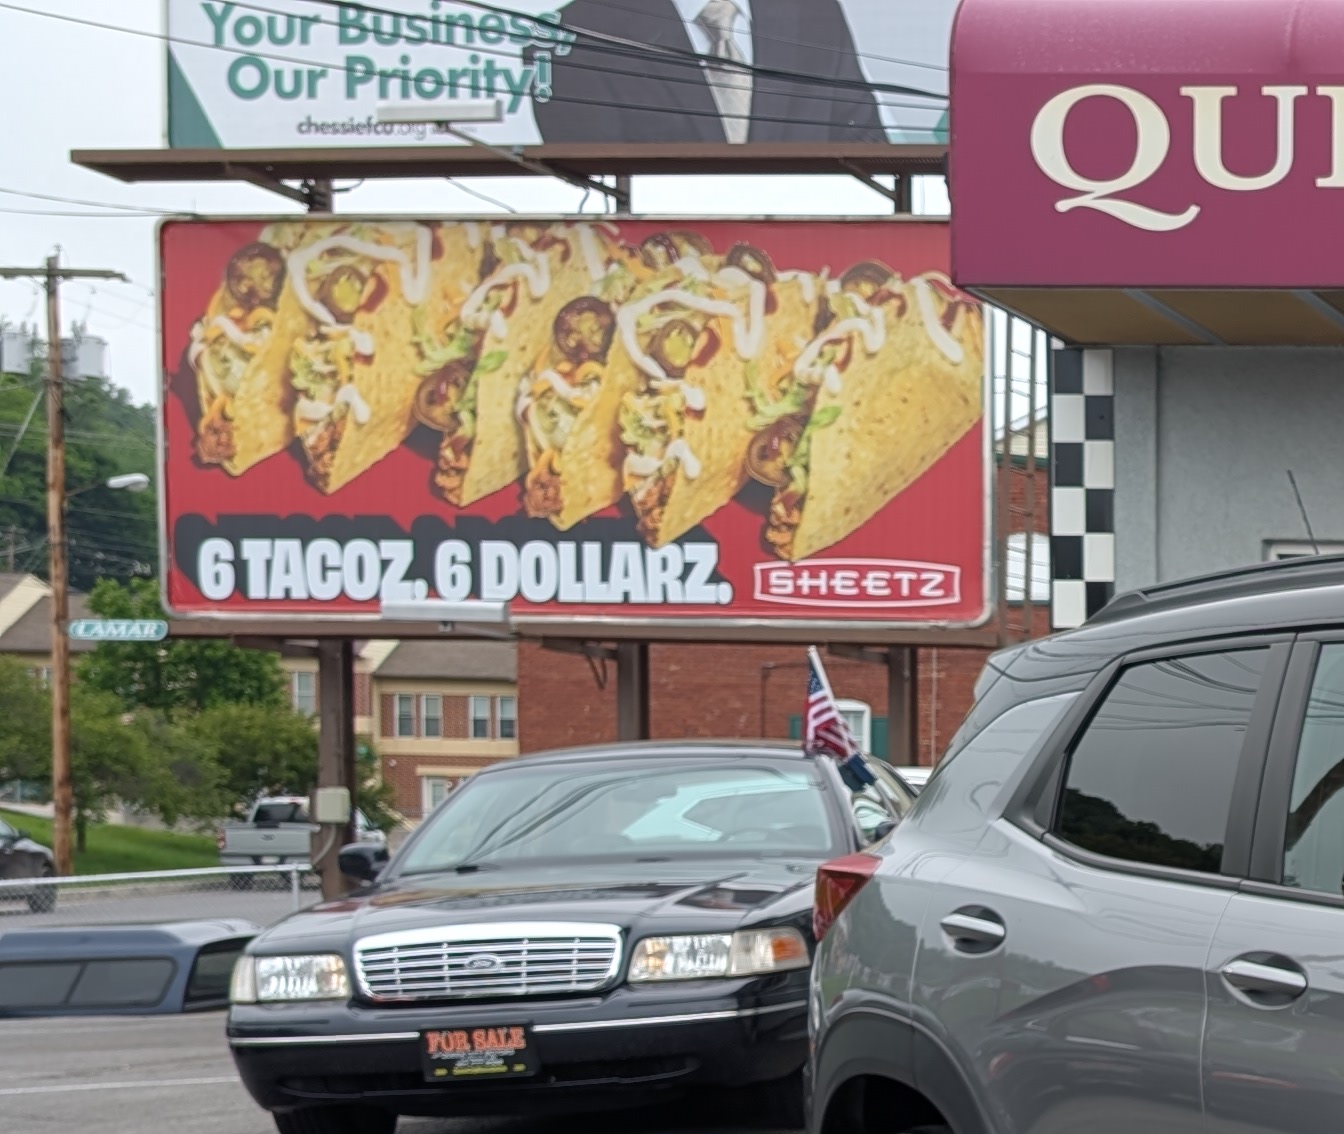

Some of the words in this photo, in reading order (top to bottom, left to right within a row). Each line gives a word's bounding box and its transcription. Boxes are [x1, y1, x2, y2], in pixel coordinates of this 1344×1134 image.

[199, 2, 321, 47] Your
[337, 1, 577, 55] Business,
[227, 54, 329, 101] Our
[344, 50, 553, 115] Priority!
[198, 537, 236, 601] 6
[241, 537, 428, 601] TACOZ.
[435, 538, 473, 602] 6
[481, 539, 734, 605] DOLLARZ.
[768, 569, 945, 597] SHEETZ
[76, 621, 159, 638] LAMAR
[425, 1029, 471, 1054] FOR
[472, 1026, 527, 1051] SALE
